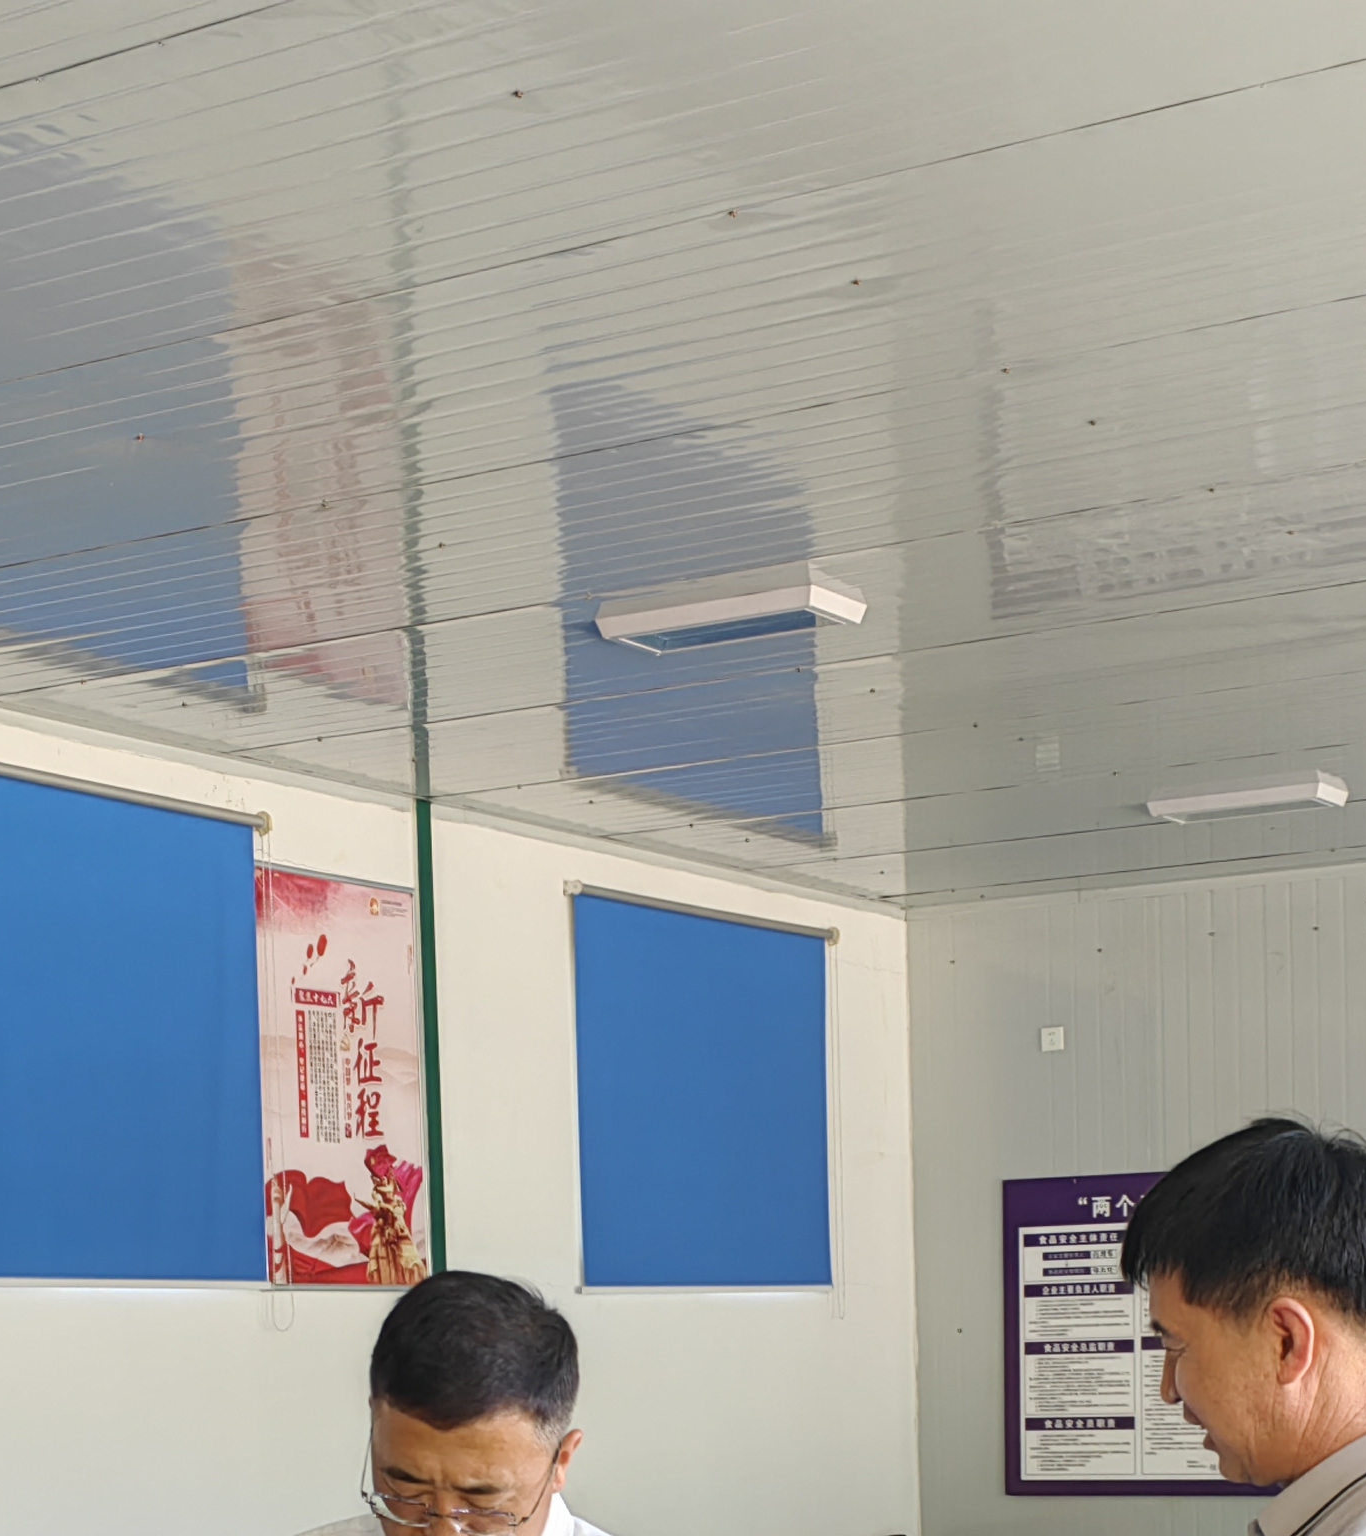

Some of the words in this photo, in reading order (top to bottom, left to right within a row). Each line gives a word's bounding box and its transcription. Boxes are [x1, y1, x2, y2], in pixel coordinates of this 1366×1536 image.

[341, 958, 384, 1139] 新征程
[1039, 1233, 1118, 1245] 食品安全主体责任
[1042, 1283, 1115, 1295] 企业主要负责人职责
[1044, 1342, 1115, 1353] 食品安全总监职责
[1044, 1419, 1116, 1429] 食品安全员职责
